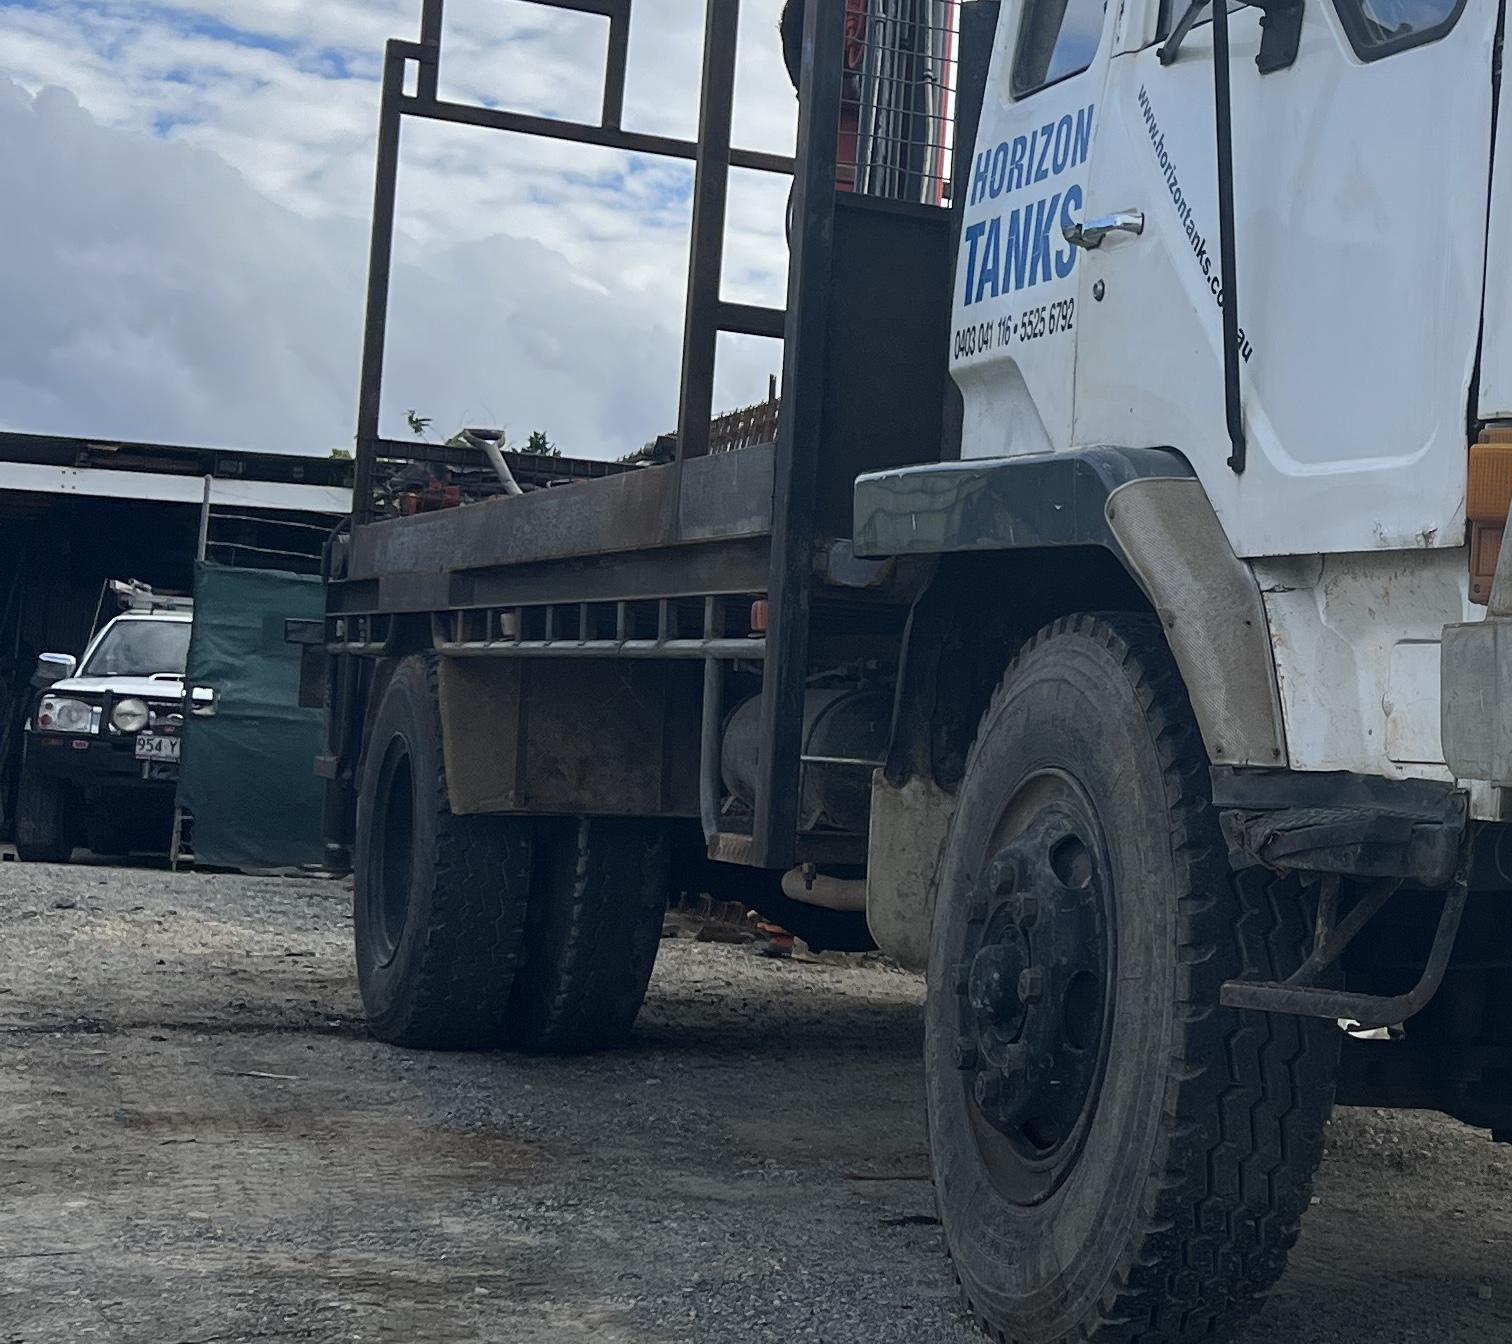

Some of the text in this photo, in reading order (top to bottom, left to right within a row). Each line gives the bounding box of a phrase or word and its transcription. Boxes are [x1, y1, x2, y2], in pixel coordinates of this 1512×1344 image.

[970, 104, 1095, 207] HORIZON
[963, 184, 1083, 307] TANKS
[1138, 84, 1253, 364] www.horizontanks.coau
[954, 297, 1075, 360] 0403 041 116 5525 6792
